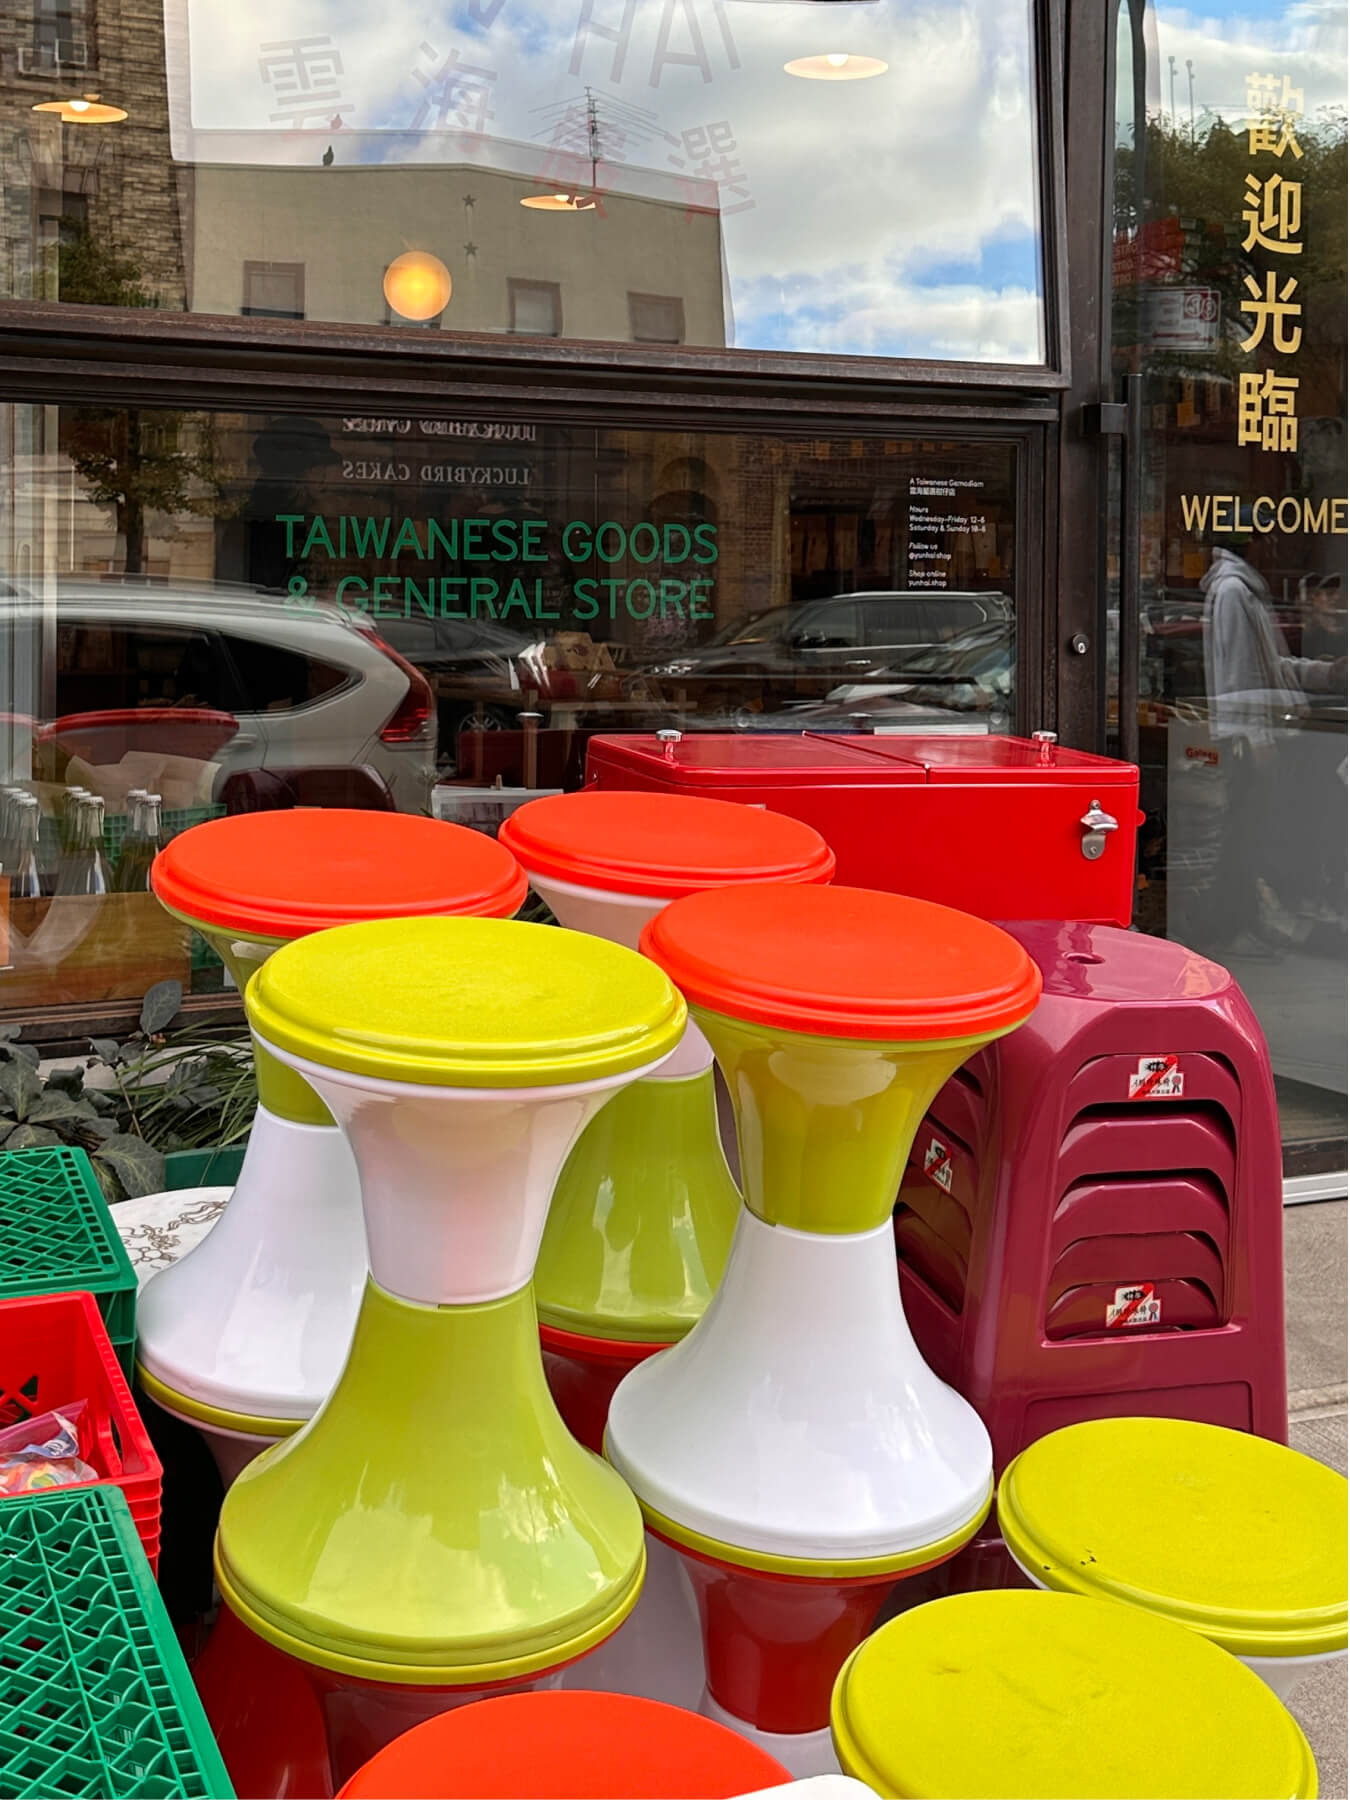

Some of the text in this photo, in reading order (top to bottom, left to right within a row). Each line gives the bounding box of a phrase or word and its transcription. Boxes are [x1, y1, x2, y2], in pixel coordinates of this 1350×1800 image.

[1238, 71, 1304, 454] 歡迎光臨
[909, 505, 929, 514] Hours
[1181, 494, 1348, 534] WELCOME
[275, 514, 719, 564] TAIWANESE GOODS
[909, 524, 939, 533] Saturday
[946, 525, 969, 534] Sunday
[909, 542, 929, 550] Follow
[909, 569, 926, 578] Shop
[282, 575, 715, 621] & GENERAL STORE
